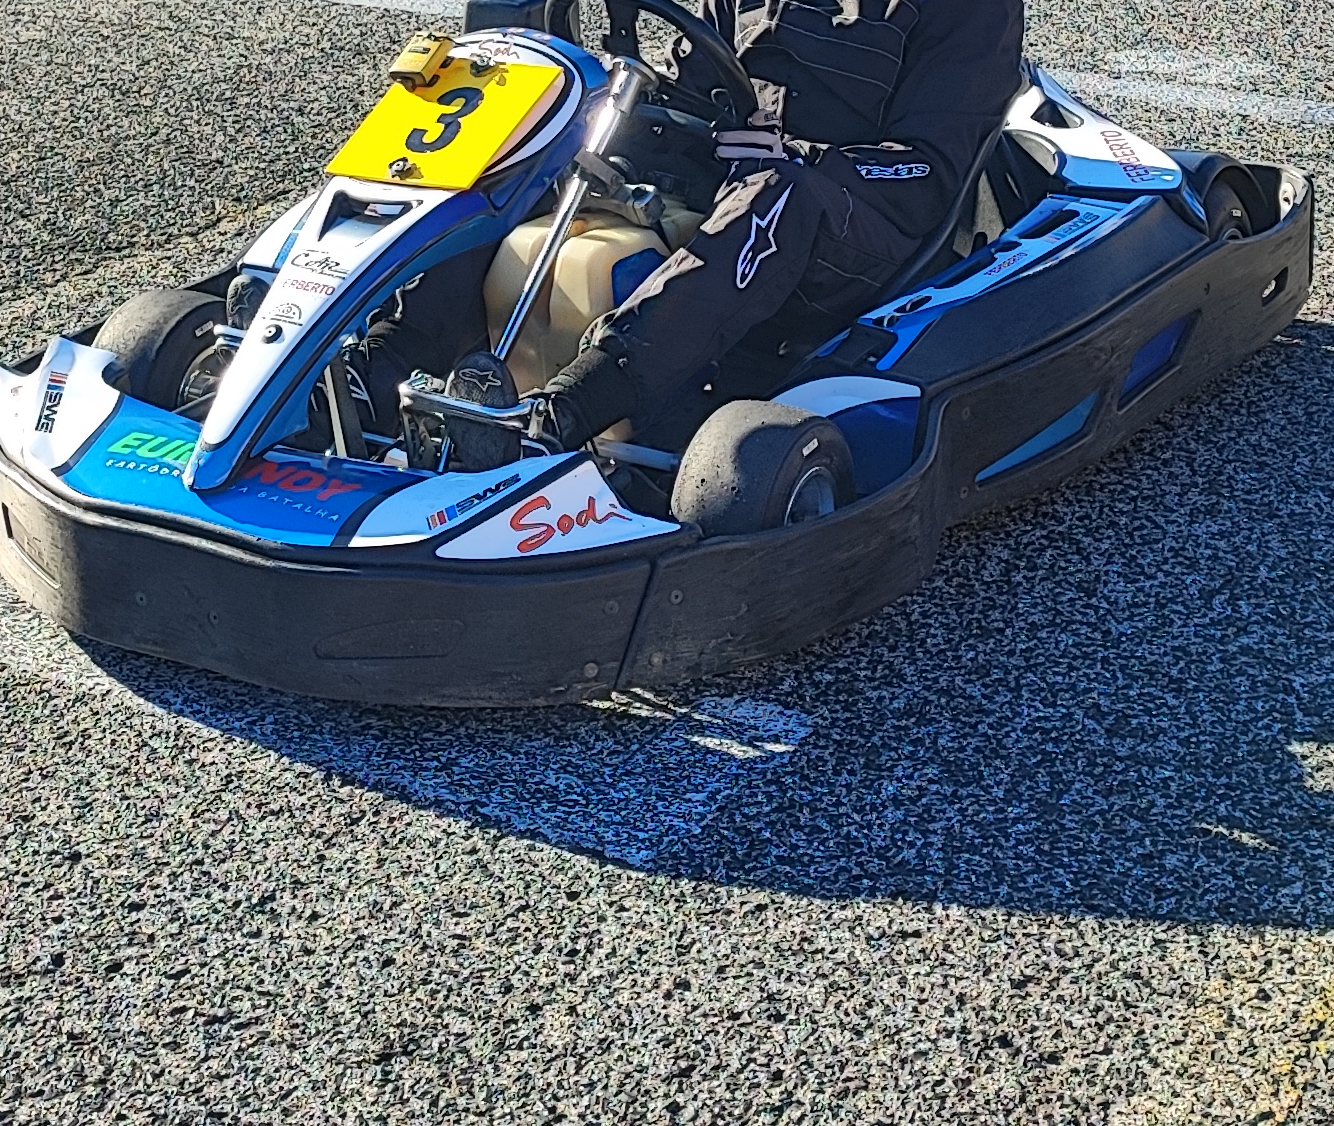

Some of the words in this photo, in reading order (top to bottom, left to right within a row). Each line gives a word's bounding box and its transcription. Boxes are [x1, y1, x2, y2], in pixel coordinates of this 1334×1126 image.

[405, 86, 485, 154] 3
[1099, 129, 1156, 184] FERBERTO
[105, 458, 182, 478] KARTÓDR
[257, 490, 342, 523] BATALHA
[509, 495, 633, 554] Sodi
